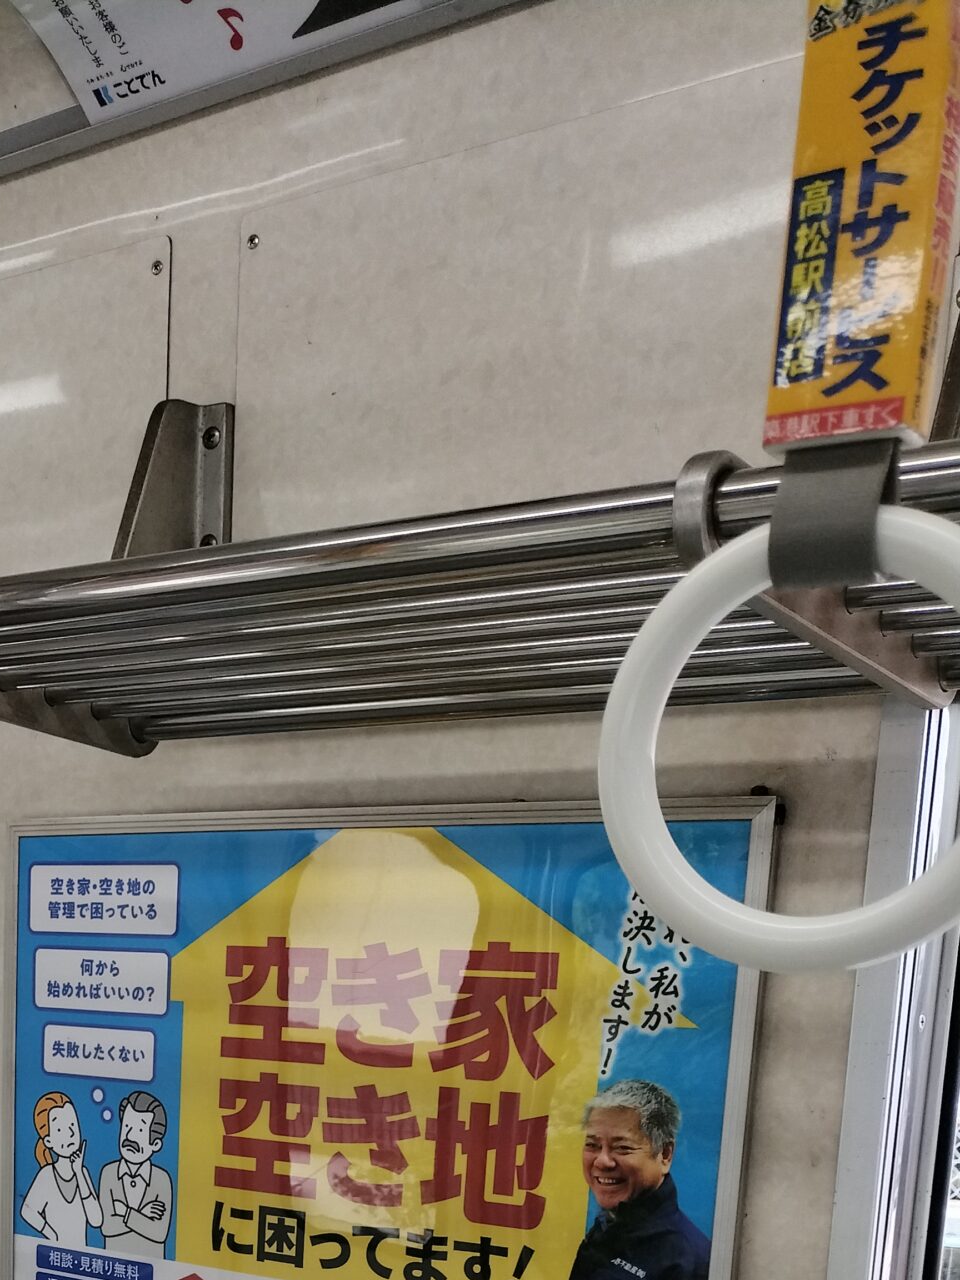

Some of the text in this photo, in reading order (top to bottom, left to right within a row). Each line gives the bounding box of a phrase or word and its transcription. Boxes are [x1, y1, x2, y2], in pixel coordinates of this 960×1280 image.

[113, 70, 166, 98] ことでん
[50, 878, 155, 896] 空き家・空き地の
[48, 901, 158, 920] 管理で困っている
[80, 958, 120, 977] 何から
[47, 980, 155, 1002] 始めればいいの?
[602, 892, 656, 1075] 決します!
[221, 936, 560, 1082] 空き家
[52, 1040, 145, 1063] 失敗したくない
[214, 1072, 550, 1230] 空き地
[48, 1250, 140, 1280] 相談・見積り無料
